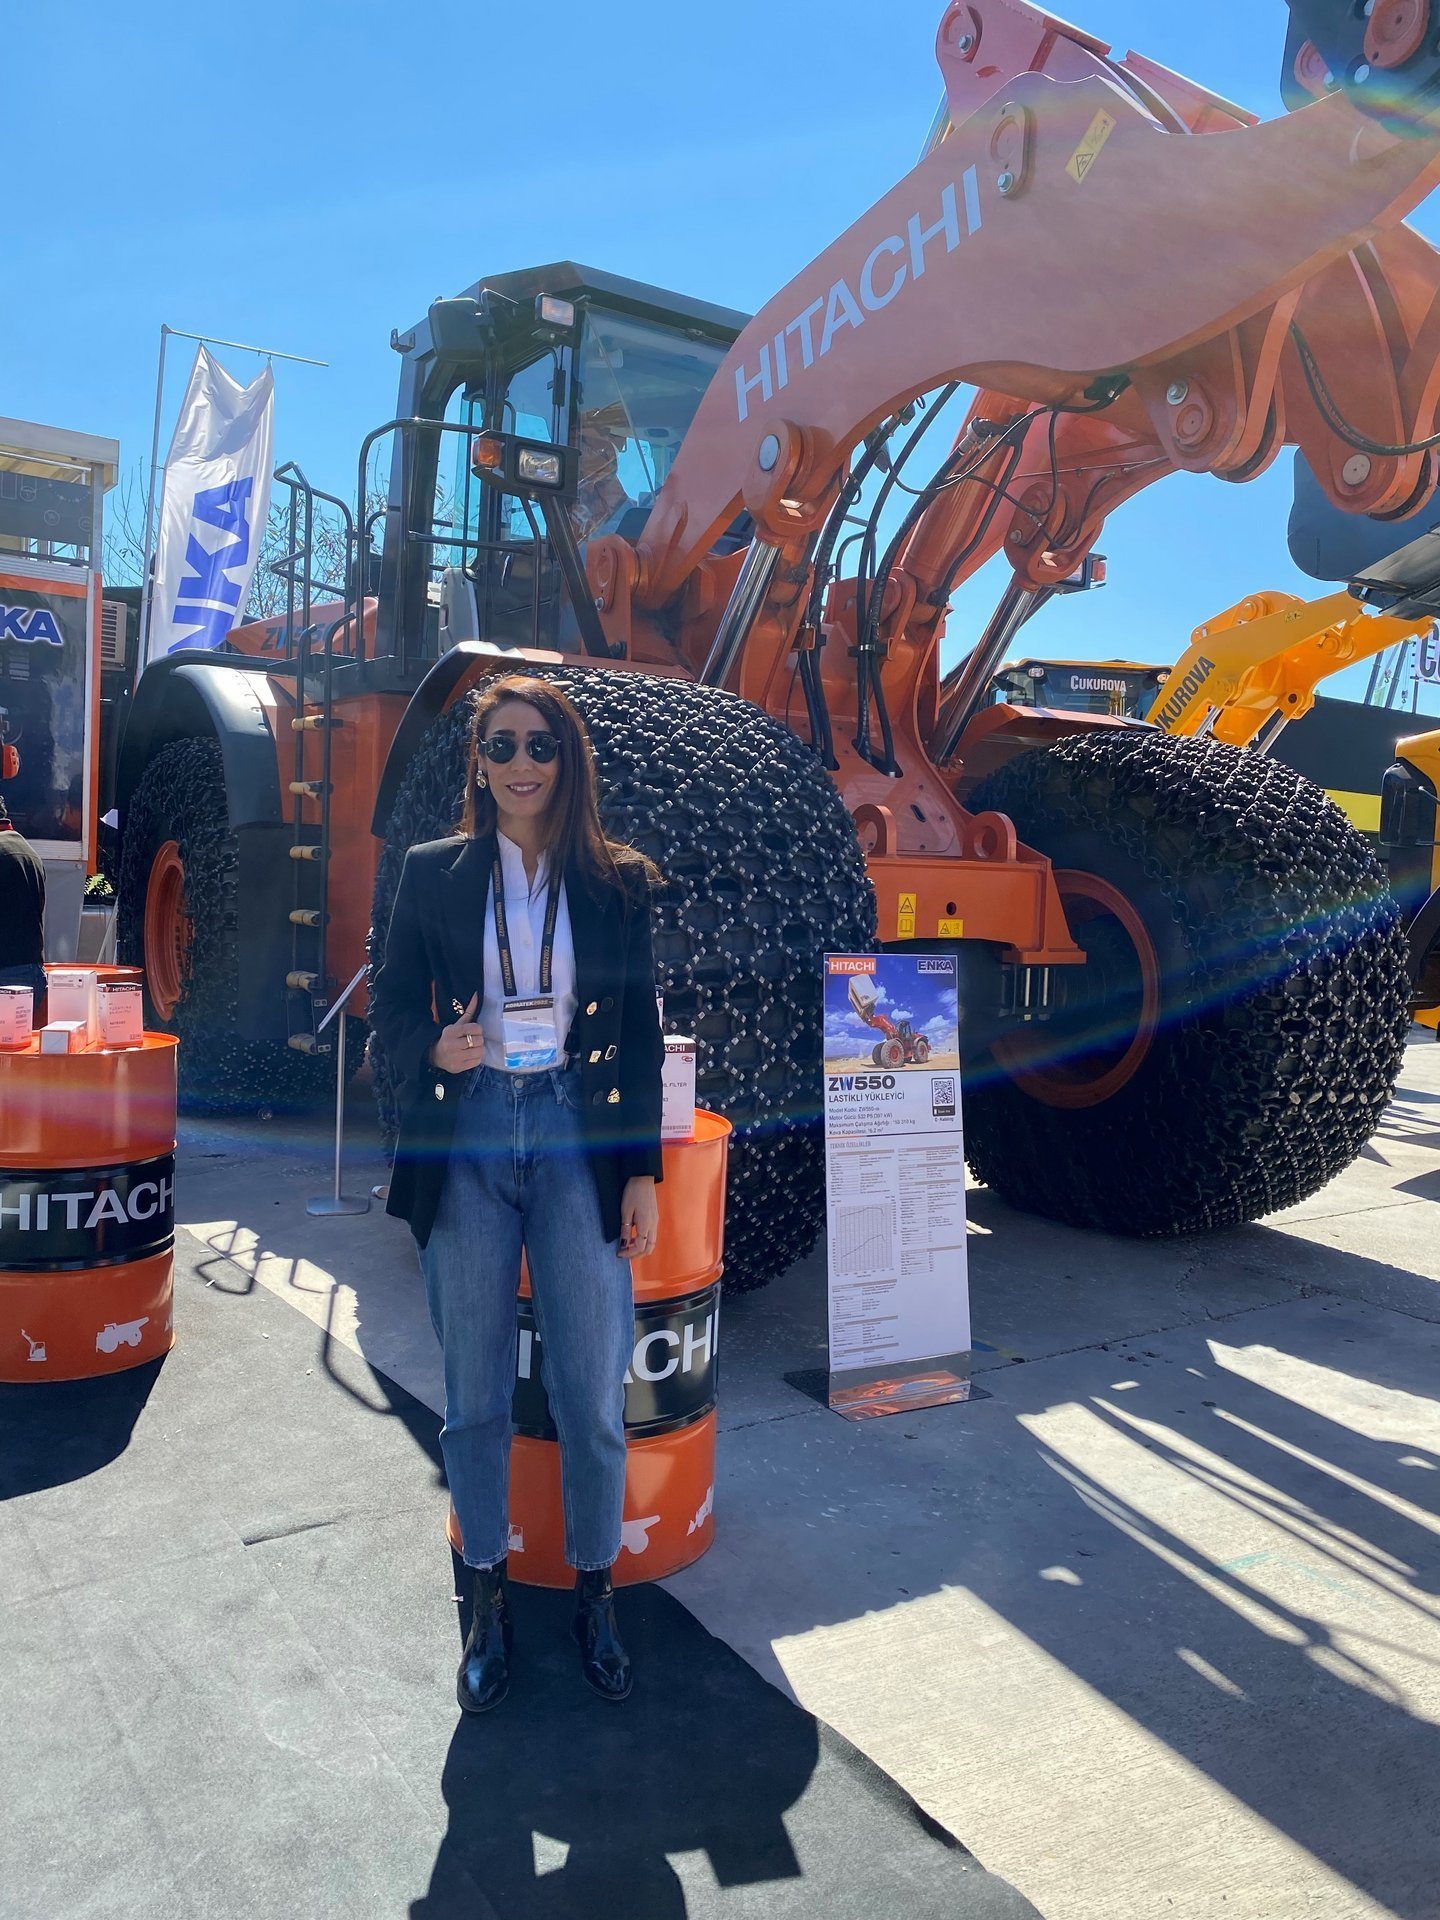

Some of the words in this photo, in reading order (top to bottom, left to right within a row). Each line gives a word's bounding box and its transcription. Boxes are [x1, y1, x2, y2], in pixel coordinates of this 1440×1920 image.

[734, 164, 983, 423] HITACHI
[1070, 675, 1127, 692] ÇUKUROVA
[830, 961, 875, 971] HITACHI
[918, 960, 954, 971] ENKA
[829, 1075, 896, 1091] ZW550
[829, 1093, 863, 1103] LASTİKLİ
[865, 1091, 905, 1101] YÜKLEYİCİ
[518, 1309, 719, 1383] ICHI
